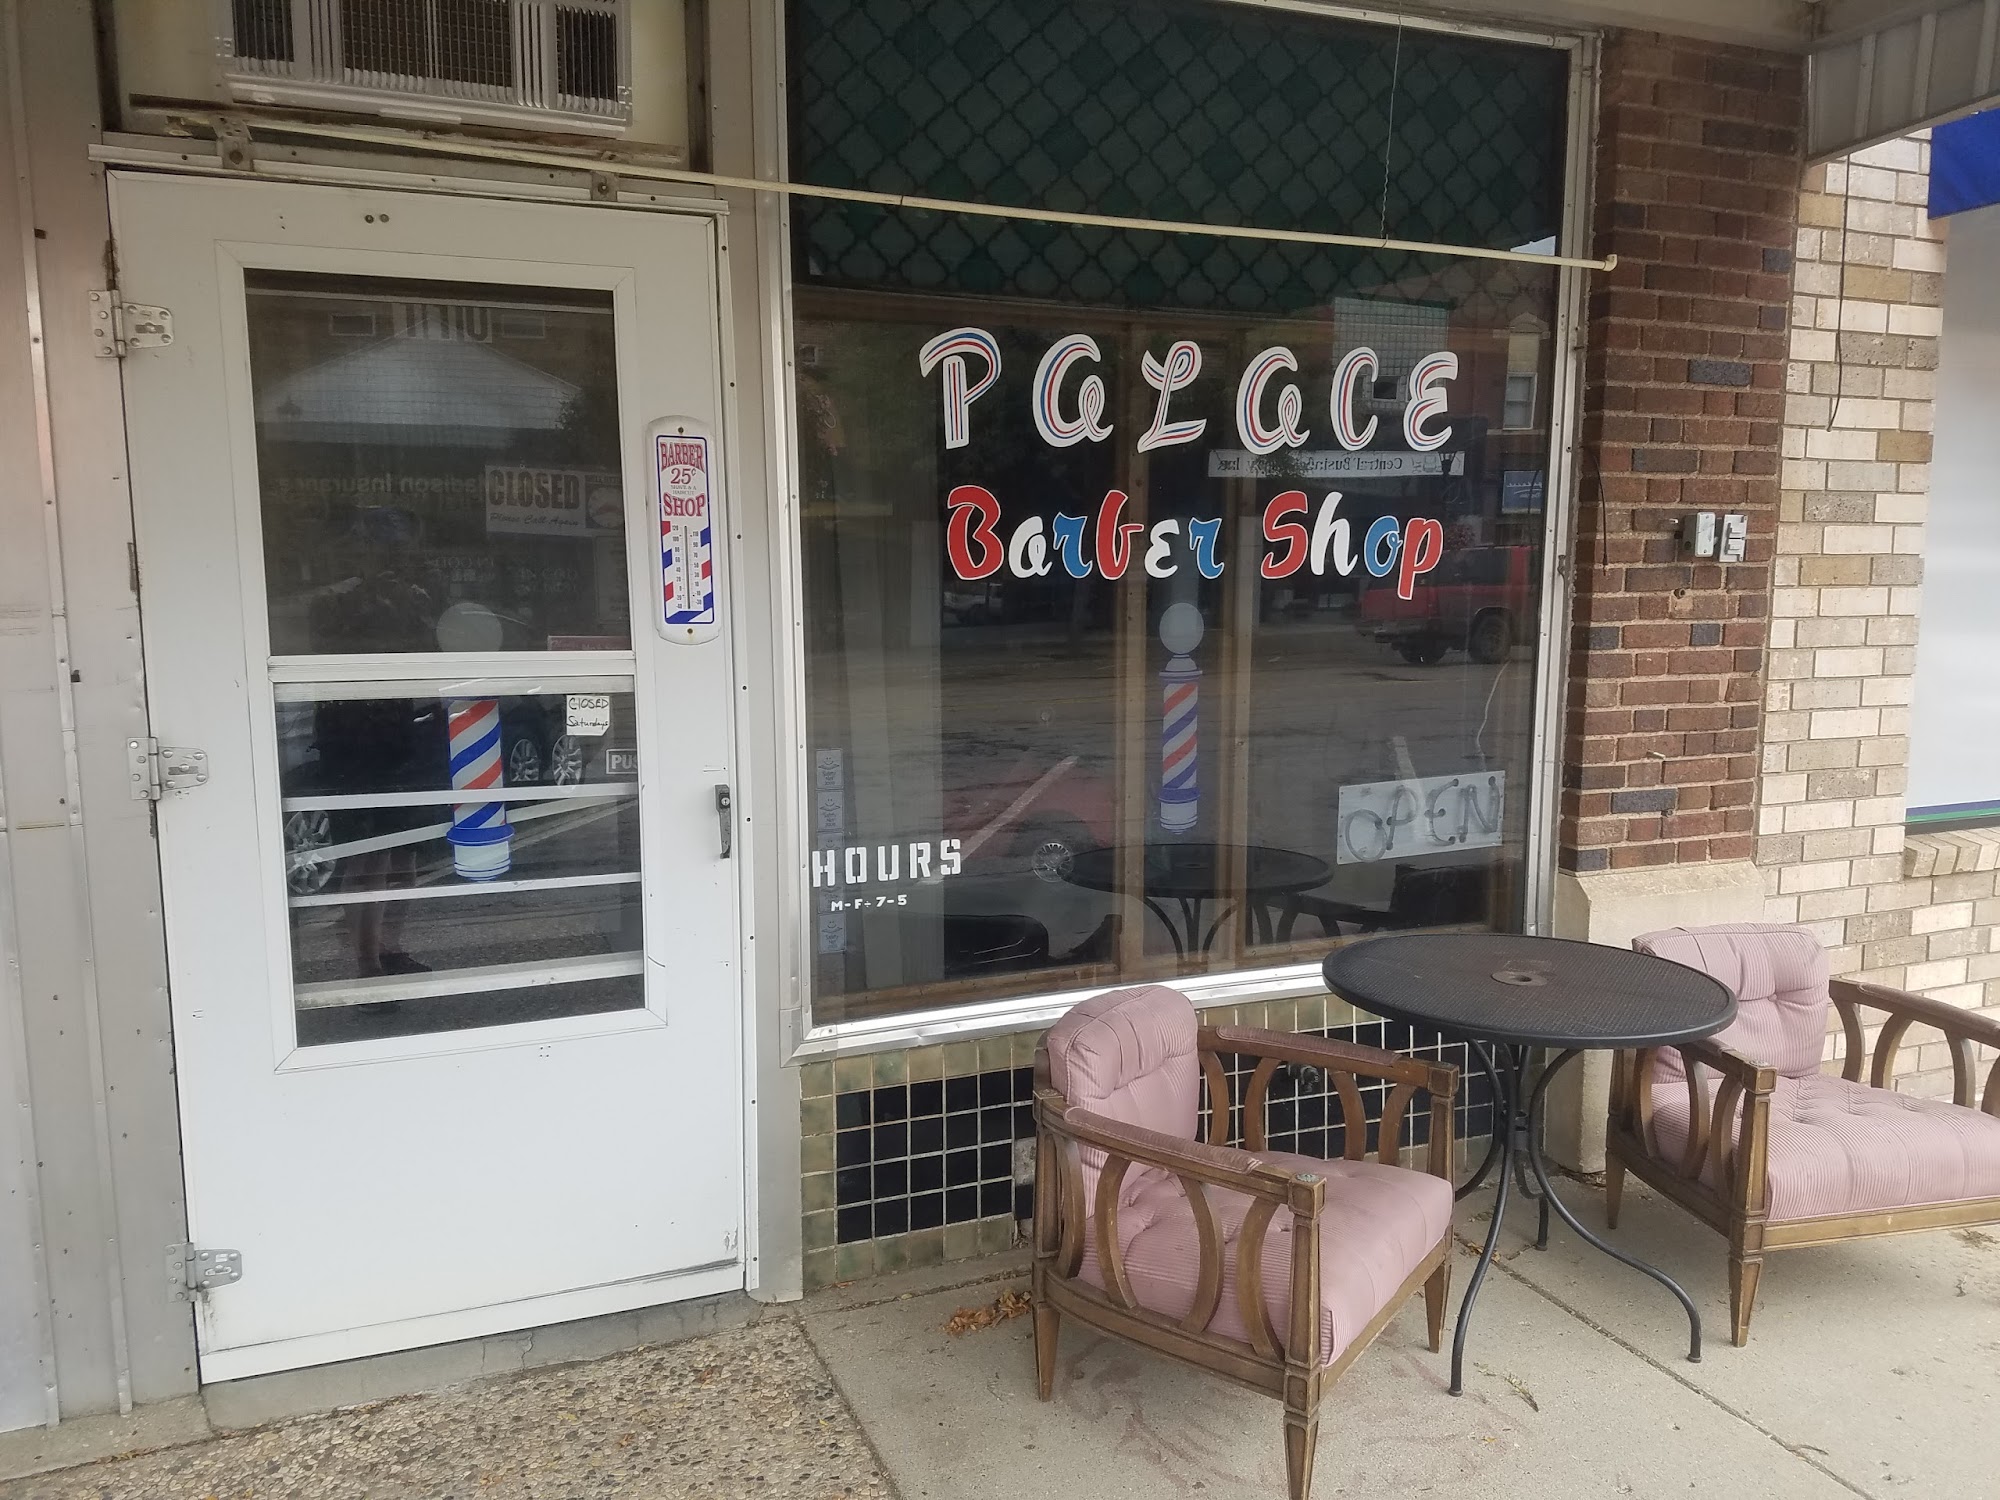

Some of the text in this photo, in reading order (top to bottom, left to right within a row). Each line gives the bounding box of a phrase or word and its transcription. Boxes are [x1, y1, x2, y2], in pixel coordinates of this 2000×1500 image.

[919, 327, 1459, 456] PALACE
[660, 442, 705, 474] BARBER
[488, 470, 580, 510] CLOSED
[663, 492, 705, 517] SHOP
[947, 485, 1444, 600] Barber Shop
[566, 715, 609, 730] Saturdays
[1345, 775, 1500, 862] OPEN
[812, 839, 962, 887] HOURS
